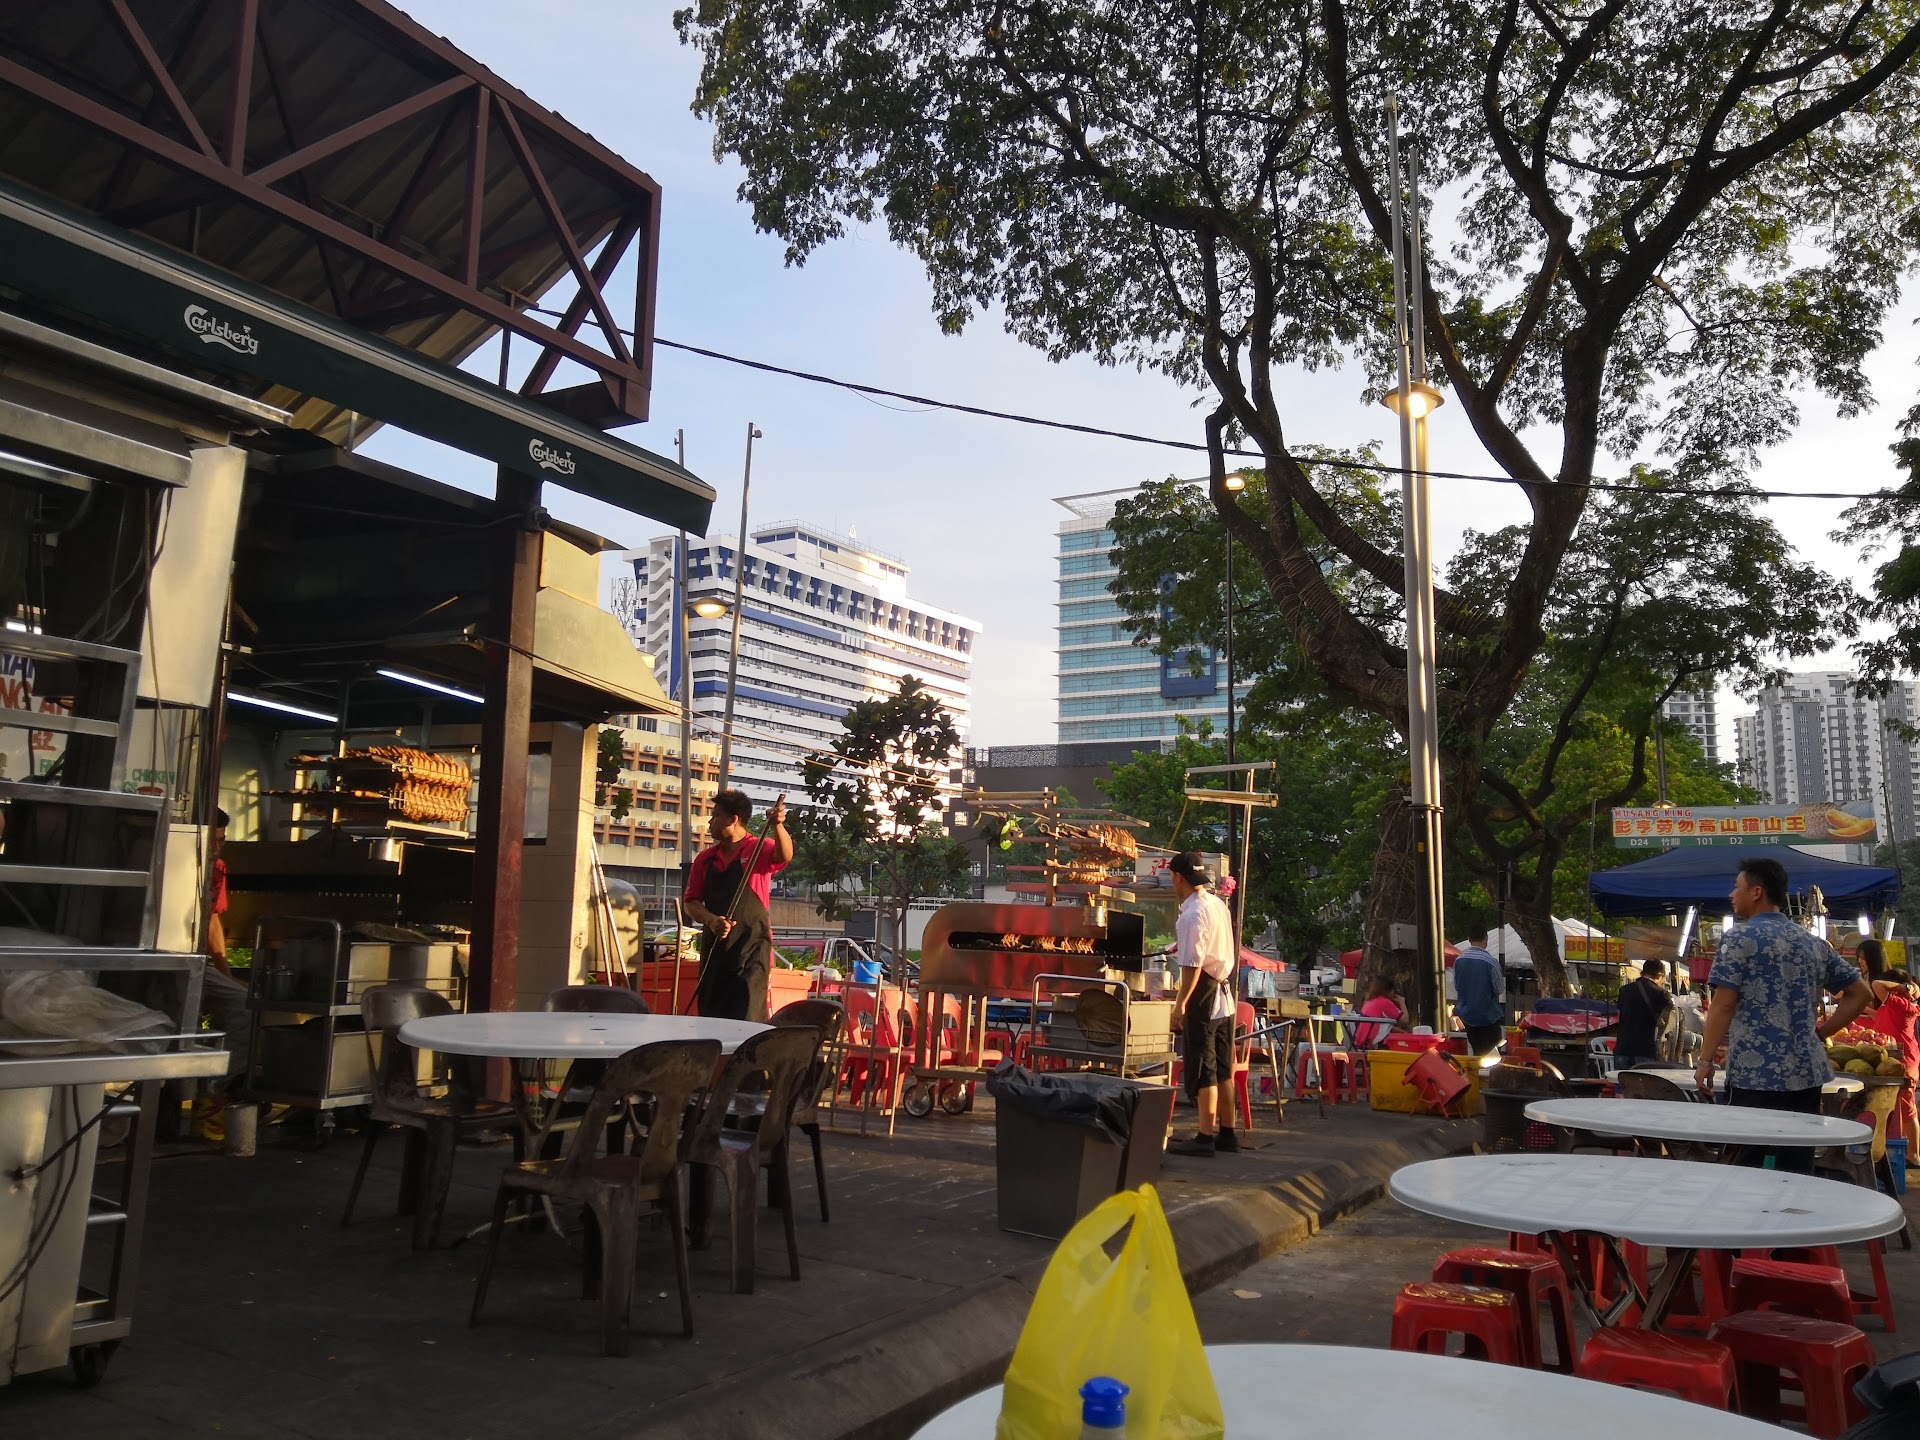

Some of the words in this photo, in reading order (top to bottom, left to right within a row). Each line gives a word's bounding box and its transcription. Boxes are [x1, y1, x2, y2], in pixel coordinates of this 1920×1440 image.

[184, 304, 259, 355] Carlsberg
[529, 438, 576, 475] Carlsberg
[1614, 809, 1660, 819] MUSANG
[1664, 808, 1692, 818] KING
[1614, 816, 1806, 835] 彭亨劳勿高山猫山王
[1630, 838, 1649, 846] D24
[1696, 837, 1713, 846] 101
[1730, 837, 1744, 845] D2
